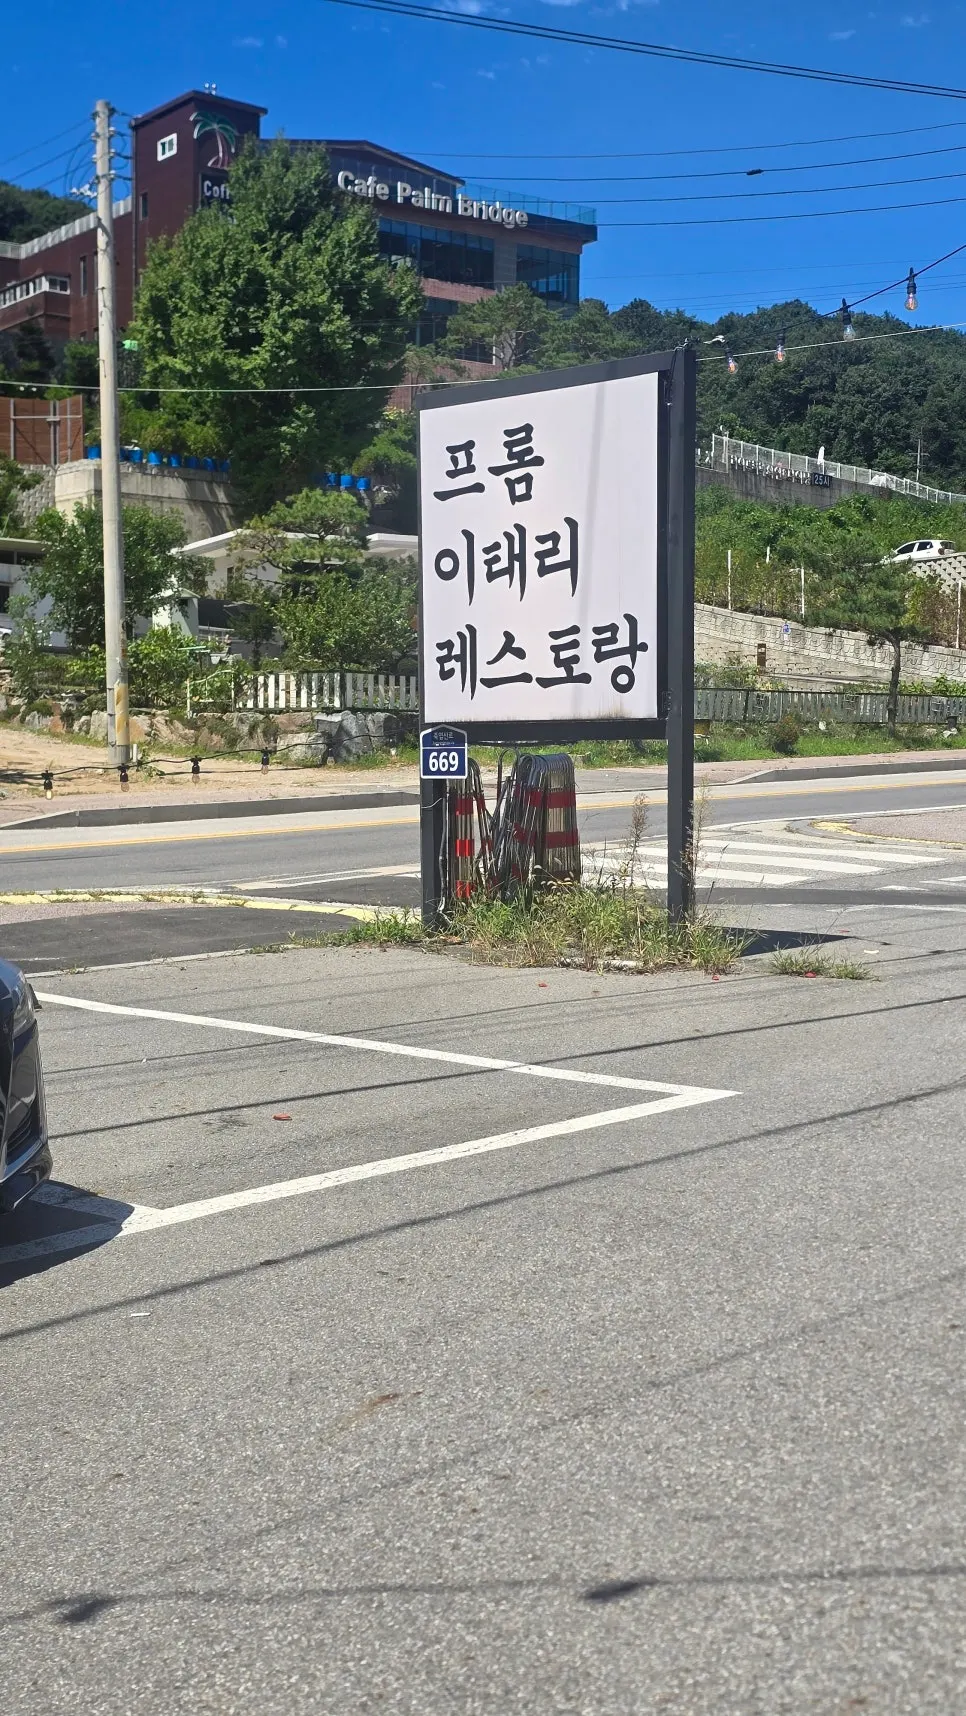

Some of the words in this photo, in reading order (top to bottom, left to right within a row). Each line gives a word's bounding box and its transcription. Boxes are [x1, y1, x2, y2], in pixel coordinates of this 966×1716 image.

[337, 170, 390, 201] Cafe
[397, 181, 453, 213] Palm
[458, 193, 529, 229] Bridge
[433, 422, 545, 506] 프롬
[434, 516, 579, 606] 이태리
[435, 613, 649, 701] 레스토랑
[428, 751, 459, 772] 669
